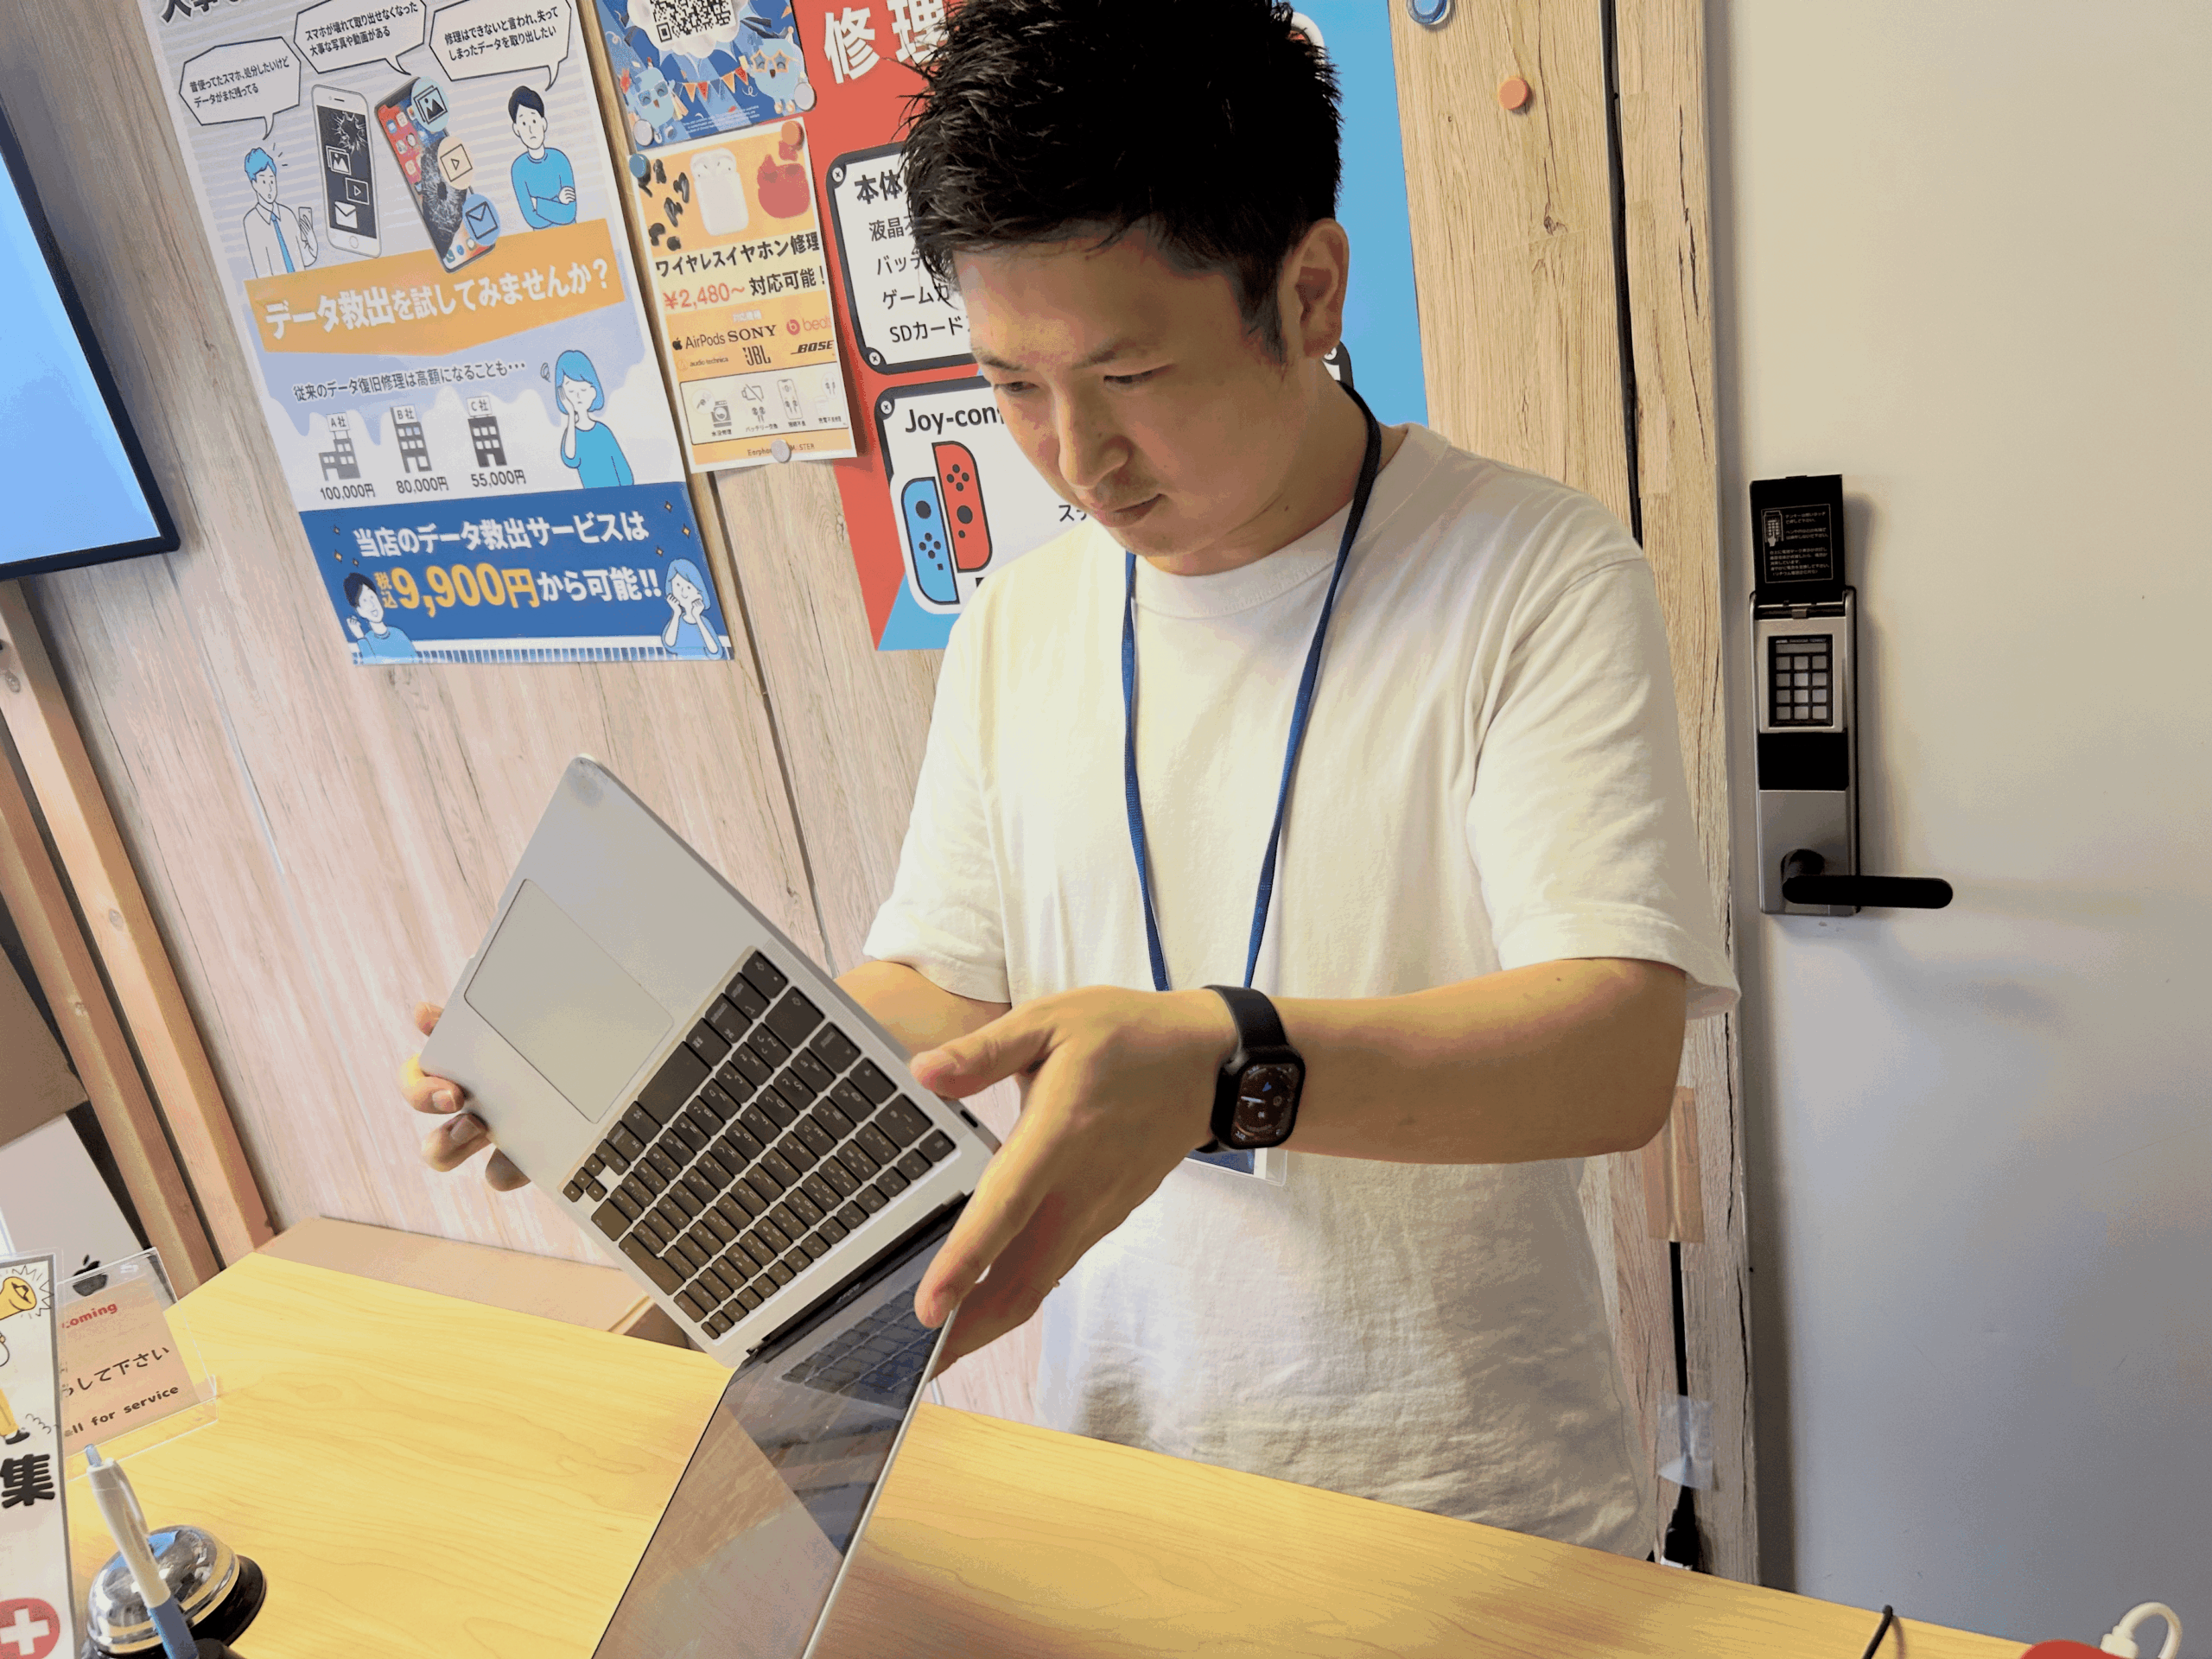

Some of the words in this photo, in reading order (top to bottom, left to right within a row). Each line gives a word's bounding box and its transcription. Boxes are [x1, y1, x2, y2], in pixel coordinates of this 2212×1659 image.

[305, 2, 418, 41] スマホが壊れて取り出せなくなった
[444, 6, 558, 46] 修理はできないと言われ、失って
[309, 25, 391, 57] 大事な写真や動画がある
[448, 26, 556, 61] しまったデータを取り出したい
[824, 0, 949, 84] 修理
[189, 56, 289, 92] 昔使ってたスマホ、処分したいけど
[194, 83, 258, 108] データがまだ残ってる
[855, 169, 909, 204] 本体
[656, 231, 820, 277] ワイヤレスイヤホン修理
[266, 258, 608, 339] データ救出を試してみませんか？
[685, 332, 726, 349] AirPods
[728, 325, 776, 343] SONY
[791, 340, 835, 354] BOSE
[890, 316, 969, 343] SDカード
[742, 345, 772, 366] JBL
[906, 406, 1004, 435] Joy-con
[320, 483, 376, 501] 100,000円
[397, 476, 449, 495] 80,000円
[471, 469, 526, 489] 55,000円
[353, 511, 650, 558] 当店のデータ救出サービスは
[91, 1411, 116, 1427] for
[124, 1386, 179, 1414] service
[0, 1453, 55, 1509] 集
